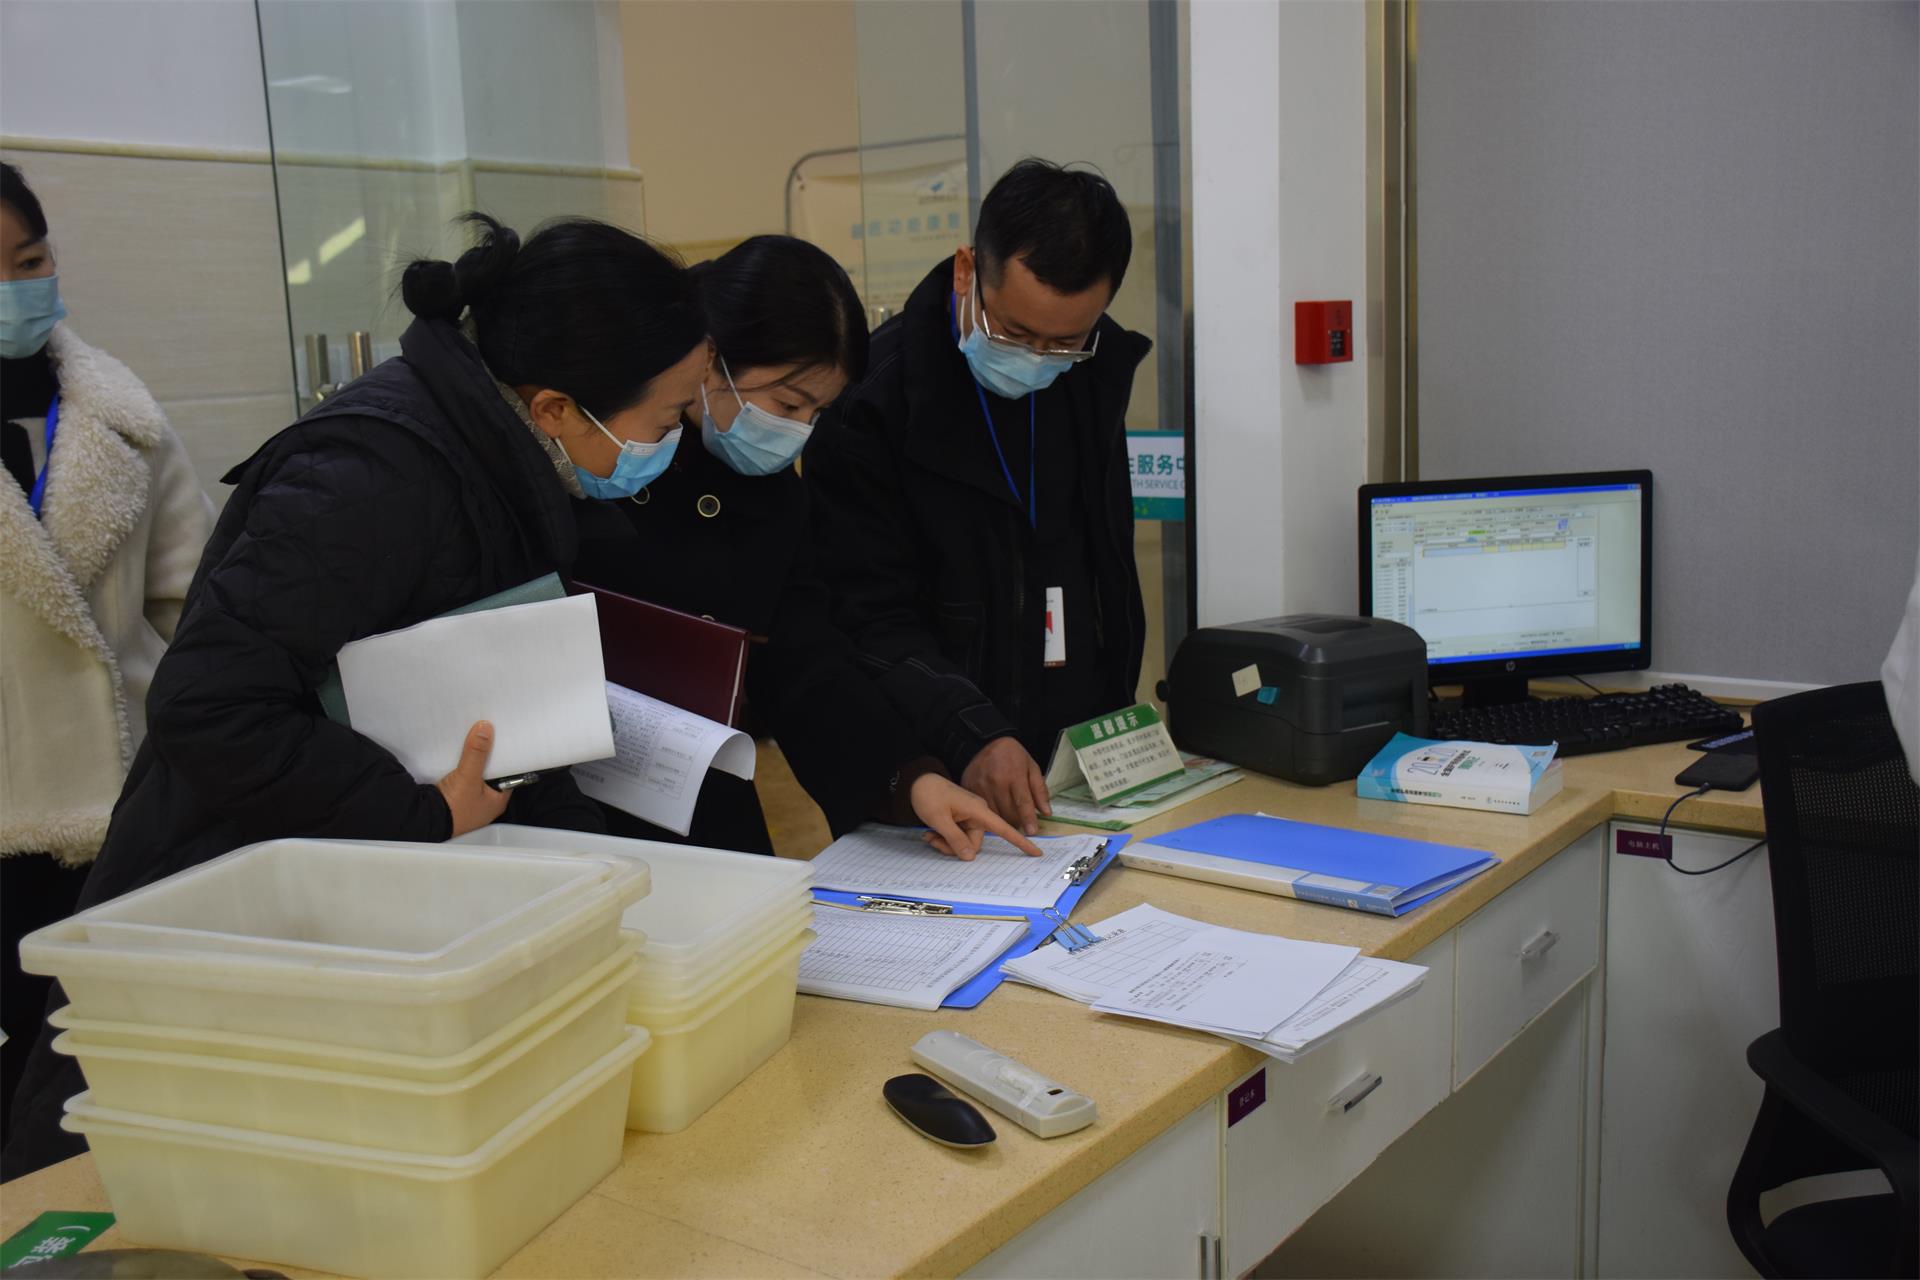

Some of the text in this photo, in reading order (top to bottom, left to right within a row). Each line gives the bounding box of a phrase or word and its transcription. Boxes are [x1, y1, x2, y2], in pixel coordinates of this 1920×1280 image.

[1145, 480, 1178, 490] SERVICE
[1628, 840, 1660, 850] 电脑主机
